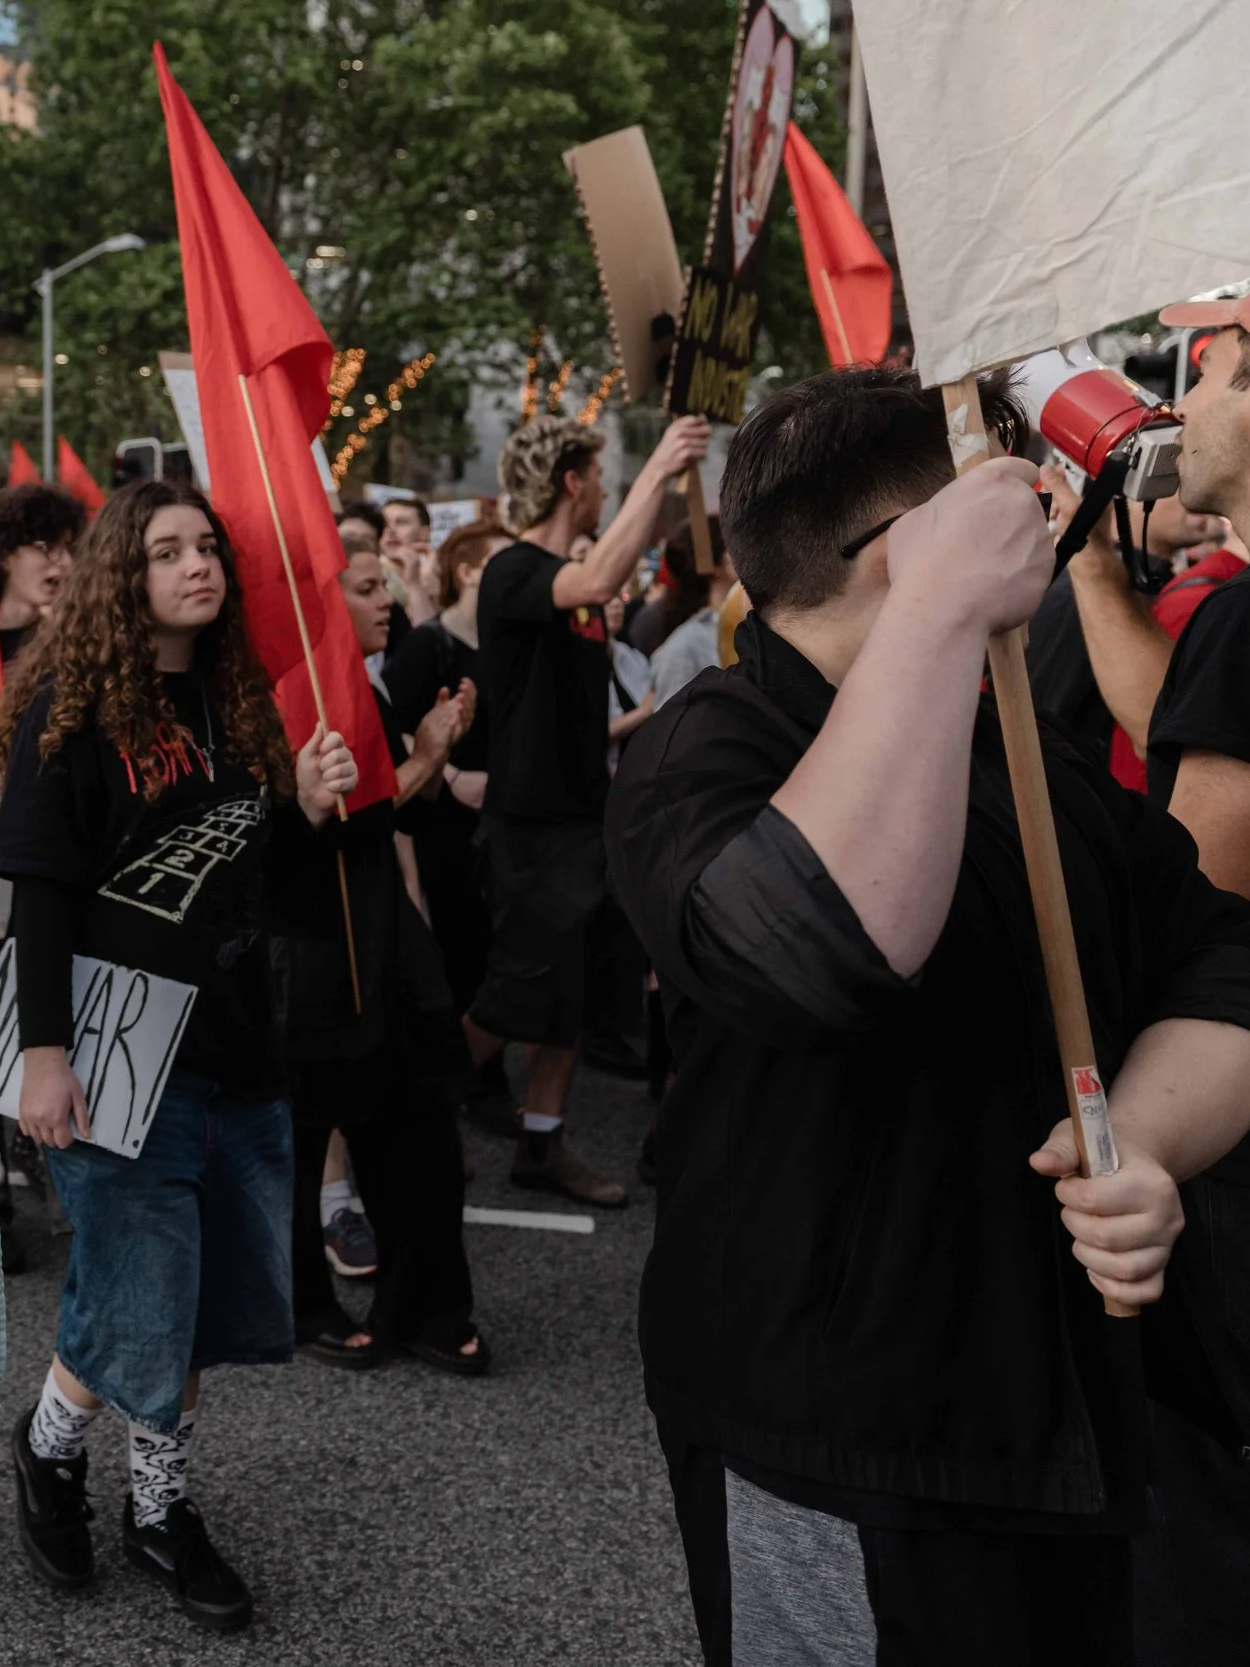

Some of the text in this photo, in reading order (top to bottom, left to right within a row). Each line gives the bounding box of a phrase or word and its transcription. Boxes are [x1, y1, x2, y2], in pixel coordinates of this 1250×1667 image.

[163, 850, 196, 869] 2
[137, 872, 166, 895] 1
[70, 965, 196, 1149] AR!
